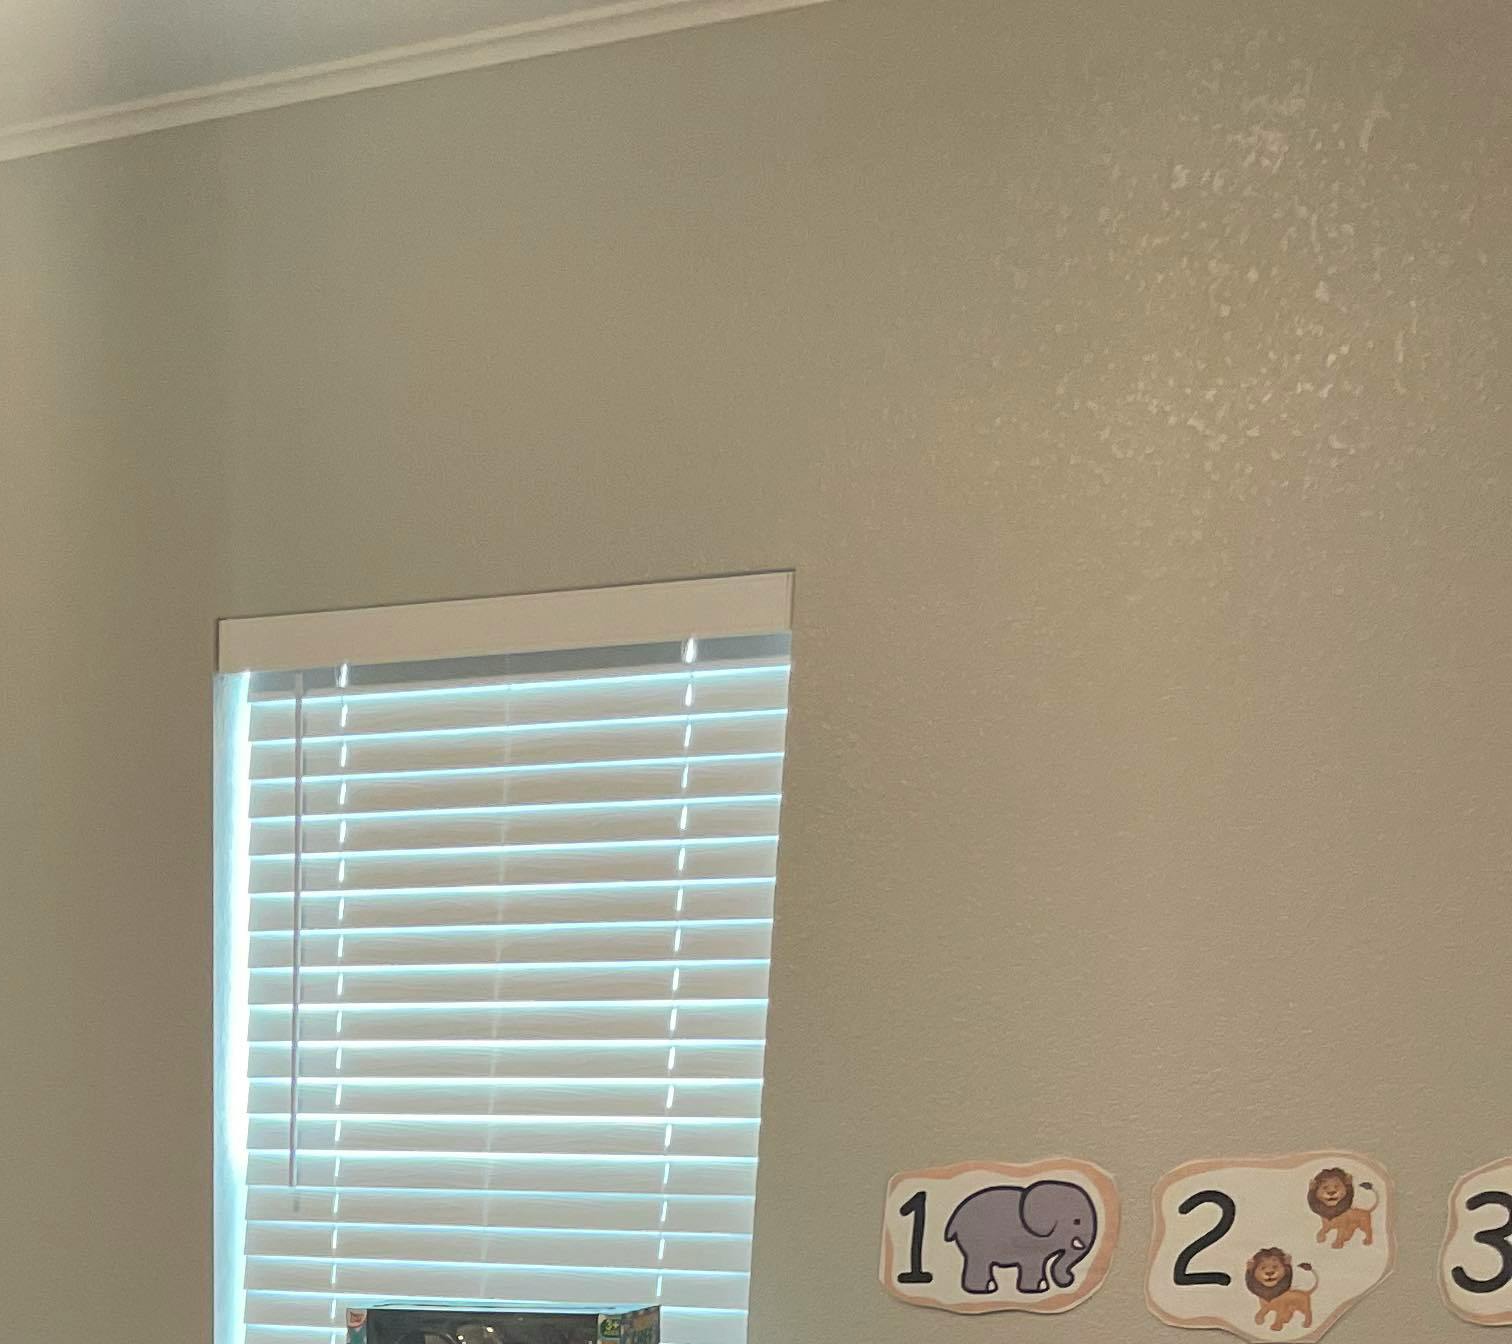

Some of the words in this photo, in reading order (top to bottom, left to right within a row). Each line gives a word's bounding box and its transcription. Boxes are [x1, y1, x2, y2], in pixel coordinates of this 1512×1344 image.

[897, 1191, 933, 1284] 1
[1173, 1190, 1236, 1287] 2
[1451, 1190, 1512, 1294] 3
